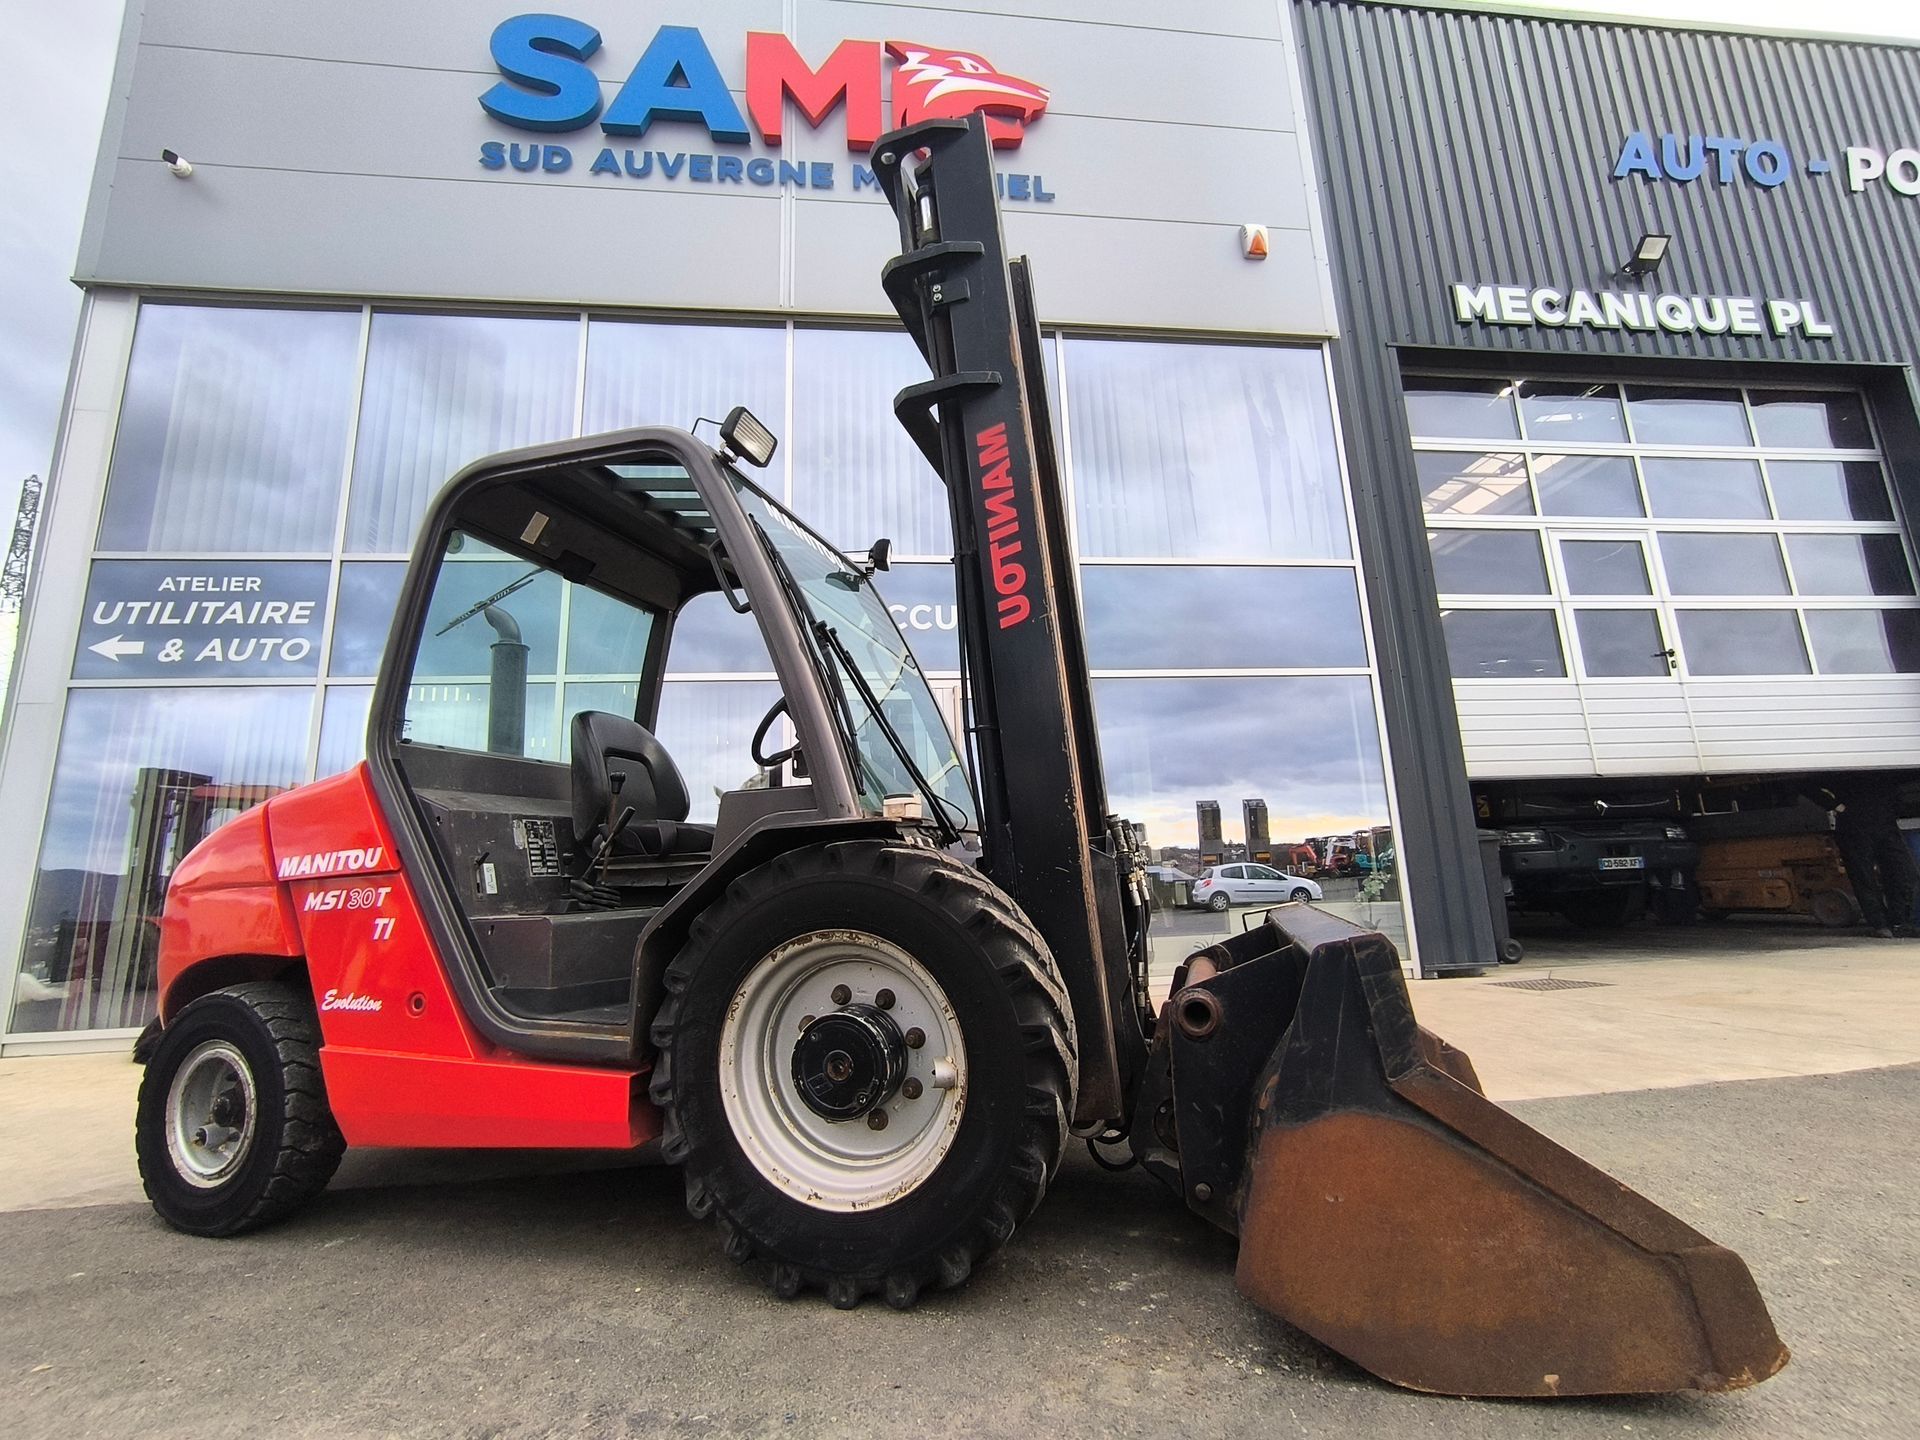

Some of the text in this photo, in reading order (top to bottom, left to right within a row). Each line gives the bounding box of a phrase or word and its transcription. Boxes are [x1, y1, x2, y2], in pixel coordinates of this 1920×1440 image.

[478, 13, 882, 152] SAM
[480, 142, 572, 173] SUD
[590, 148, 834, 189] AUVERGNE
[1613, 131, 1790, 187] AUTO
[1453, 283, 1834, 337] MECANIQUE PL
[975, 421, 1031, 630] MANITOU
[158, 576, 262, 592] ATELIER
[92, 601, 316, 625] UTILITAIRE
[157, 638, 311, 663] & AUTO
[278, 846, 383, 878] MANITOU
[372, 917, 396, 940] TI
[321, 988, 382, 1012] Evolution
